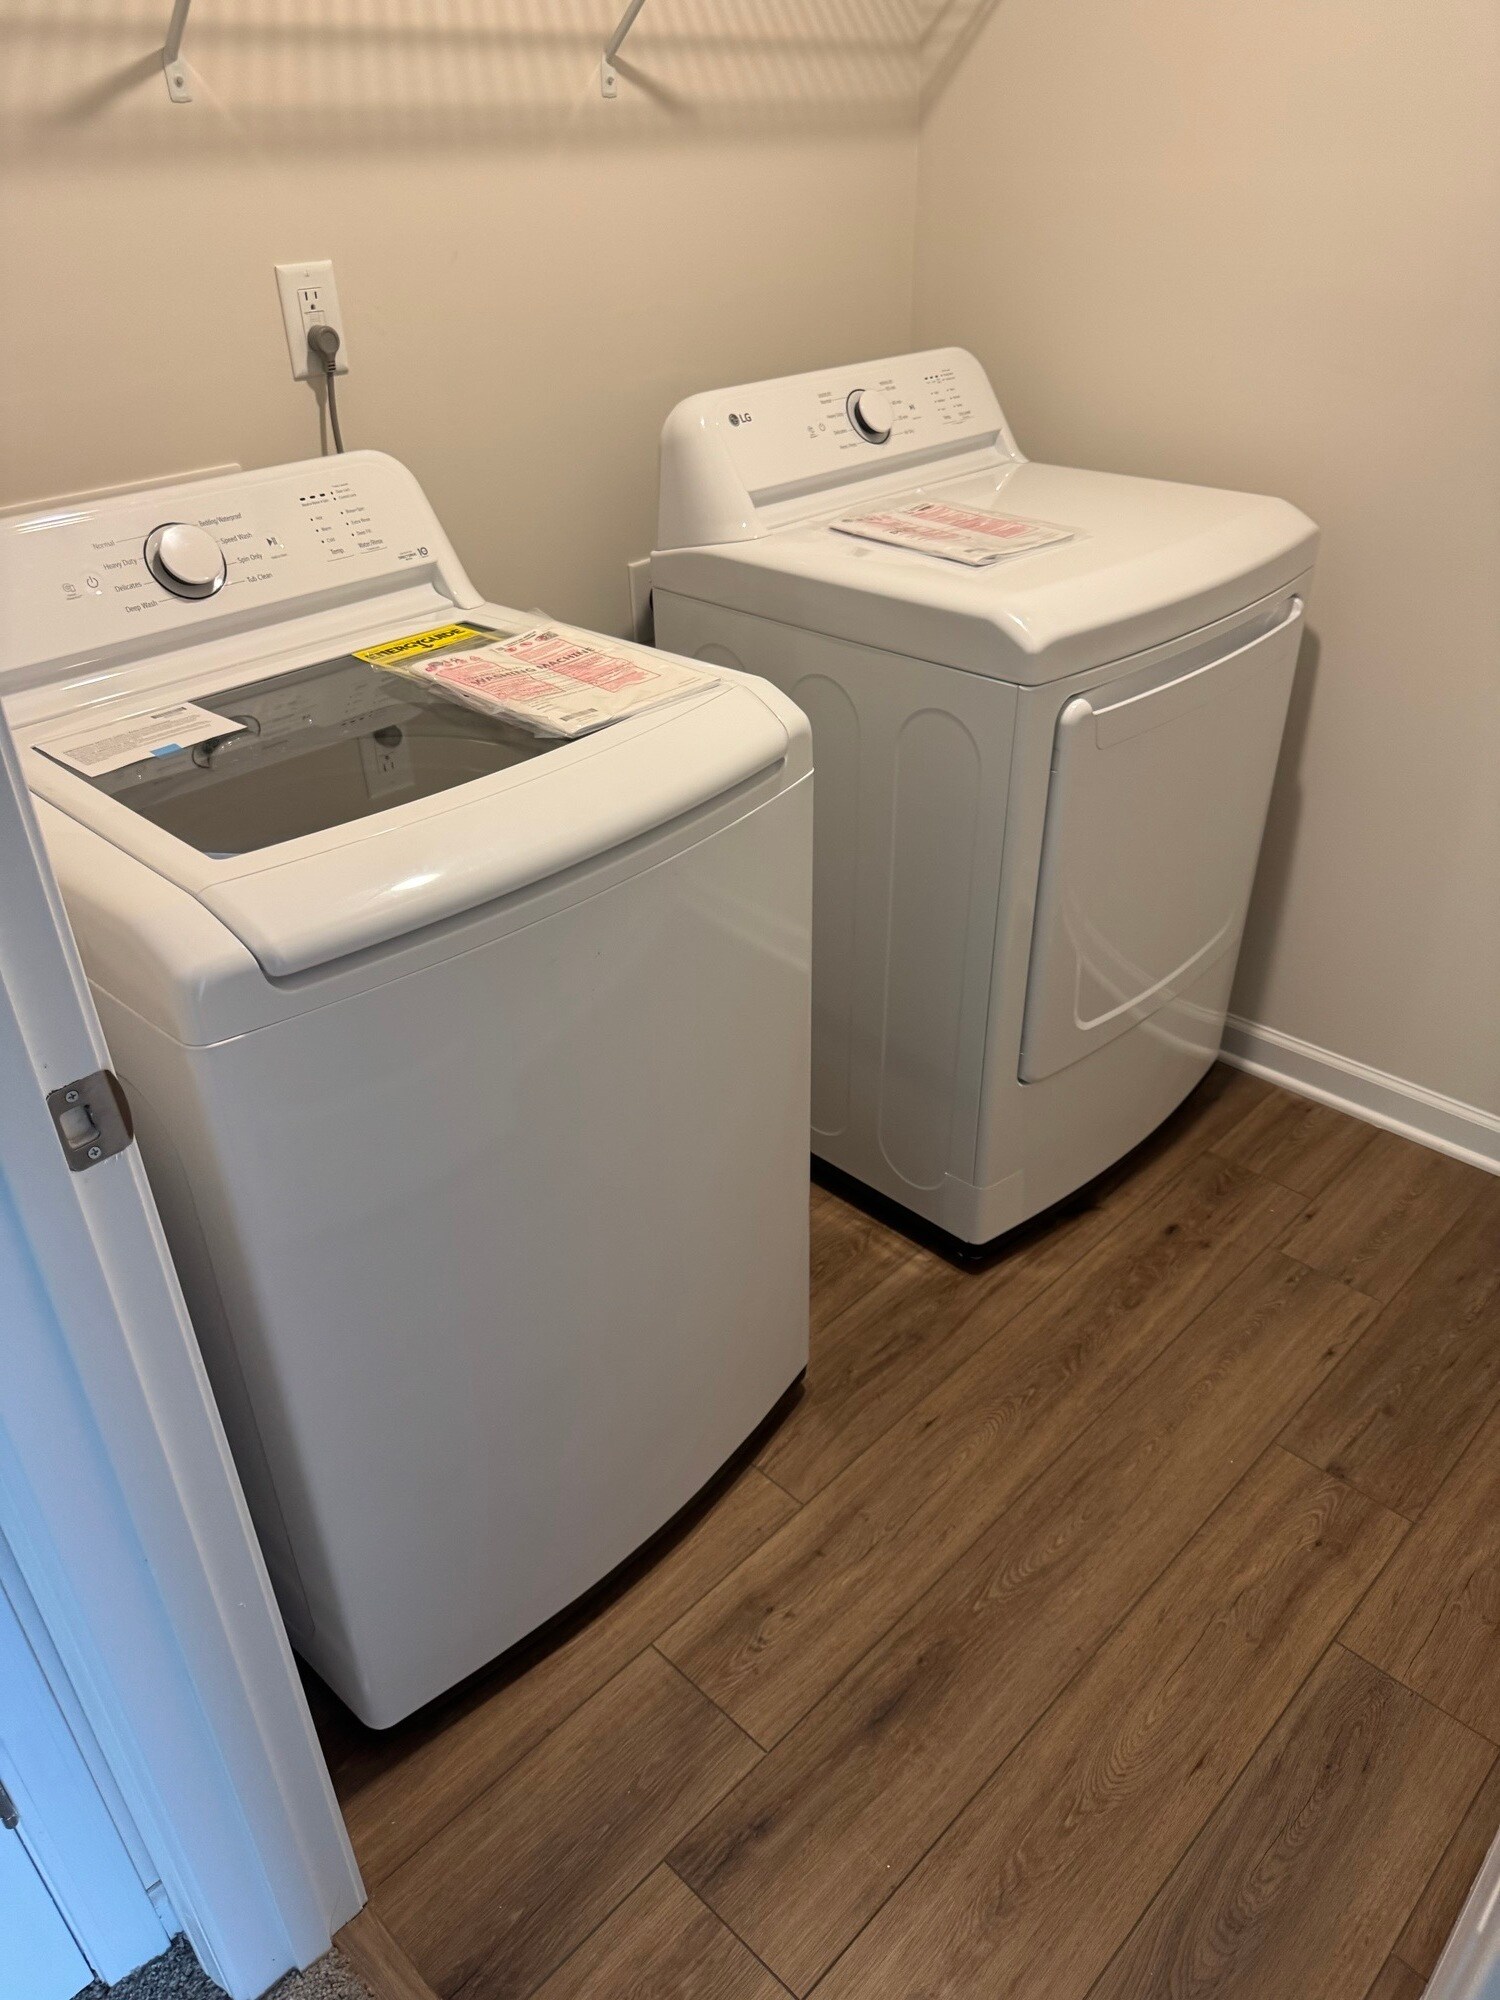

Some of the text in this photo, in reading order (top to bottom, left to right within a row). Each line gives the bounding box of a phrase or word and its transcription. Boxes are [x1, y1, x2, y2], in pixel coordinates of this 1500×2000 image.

[739, 412, 752, 423] LG
[220, 532, 253, 545] Speed Wash
[92, 540, 116, 550] Normal
[330, 547, 344, 555] Temp
[237, 556, 250, 564] Spin
[249, 552, 263, 561] Only
[102, 558, 138, 571] Heavy Duty
[246, 572, 273, 583] Tub Clean
[114, 582, 142, 593] Delicates
[125, 600, 158, 614] Deep Wash
[536, 646, 597, 670] MACHINE
